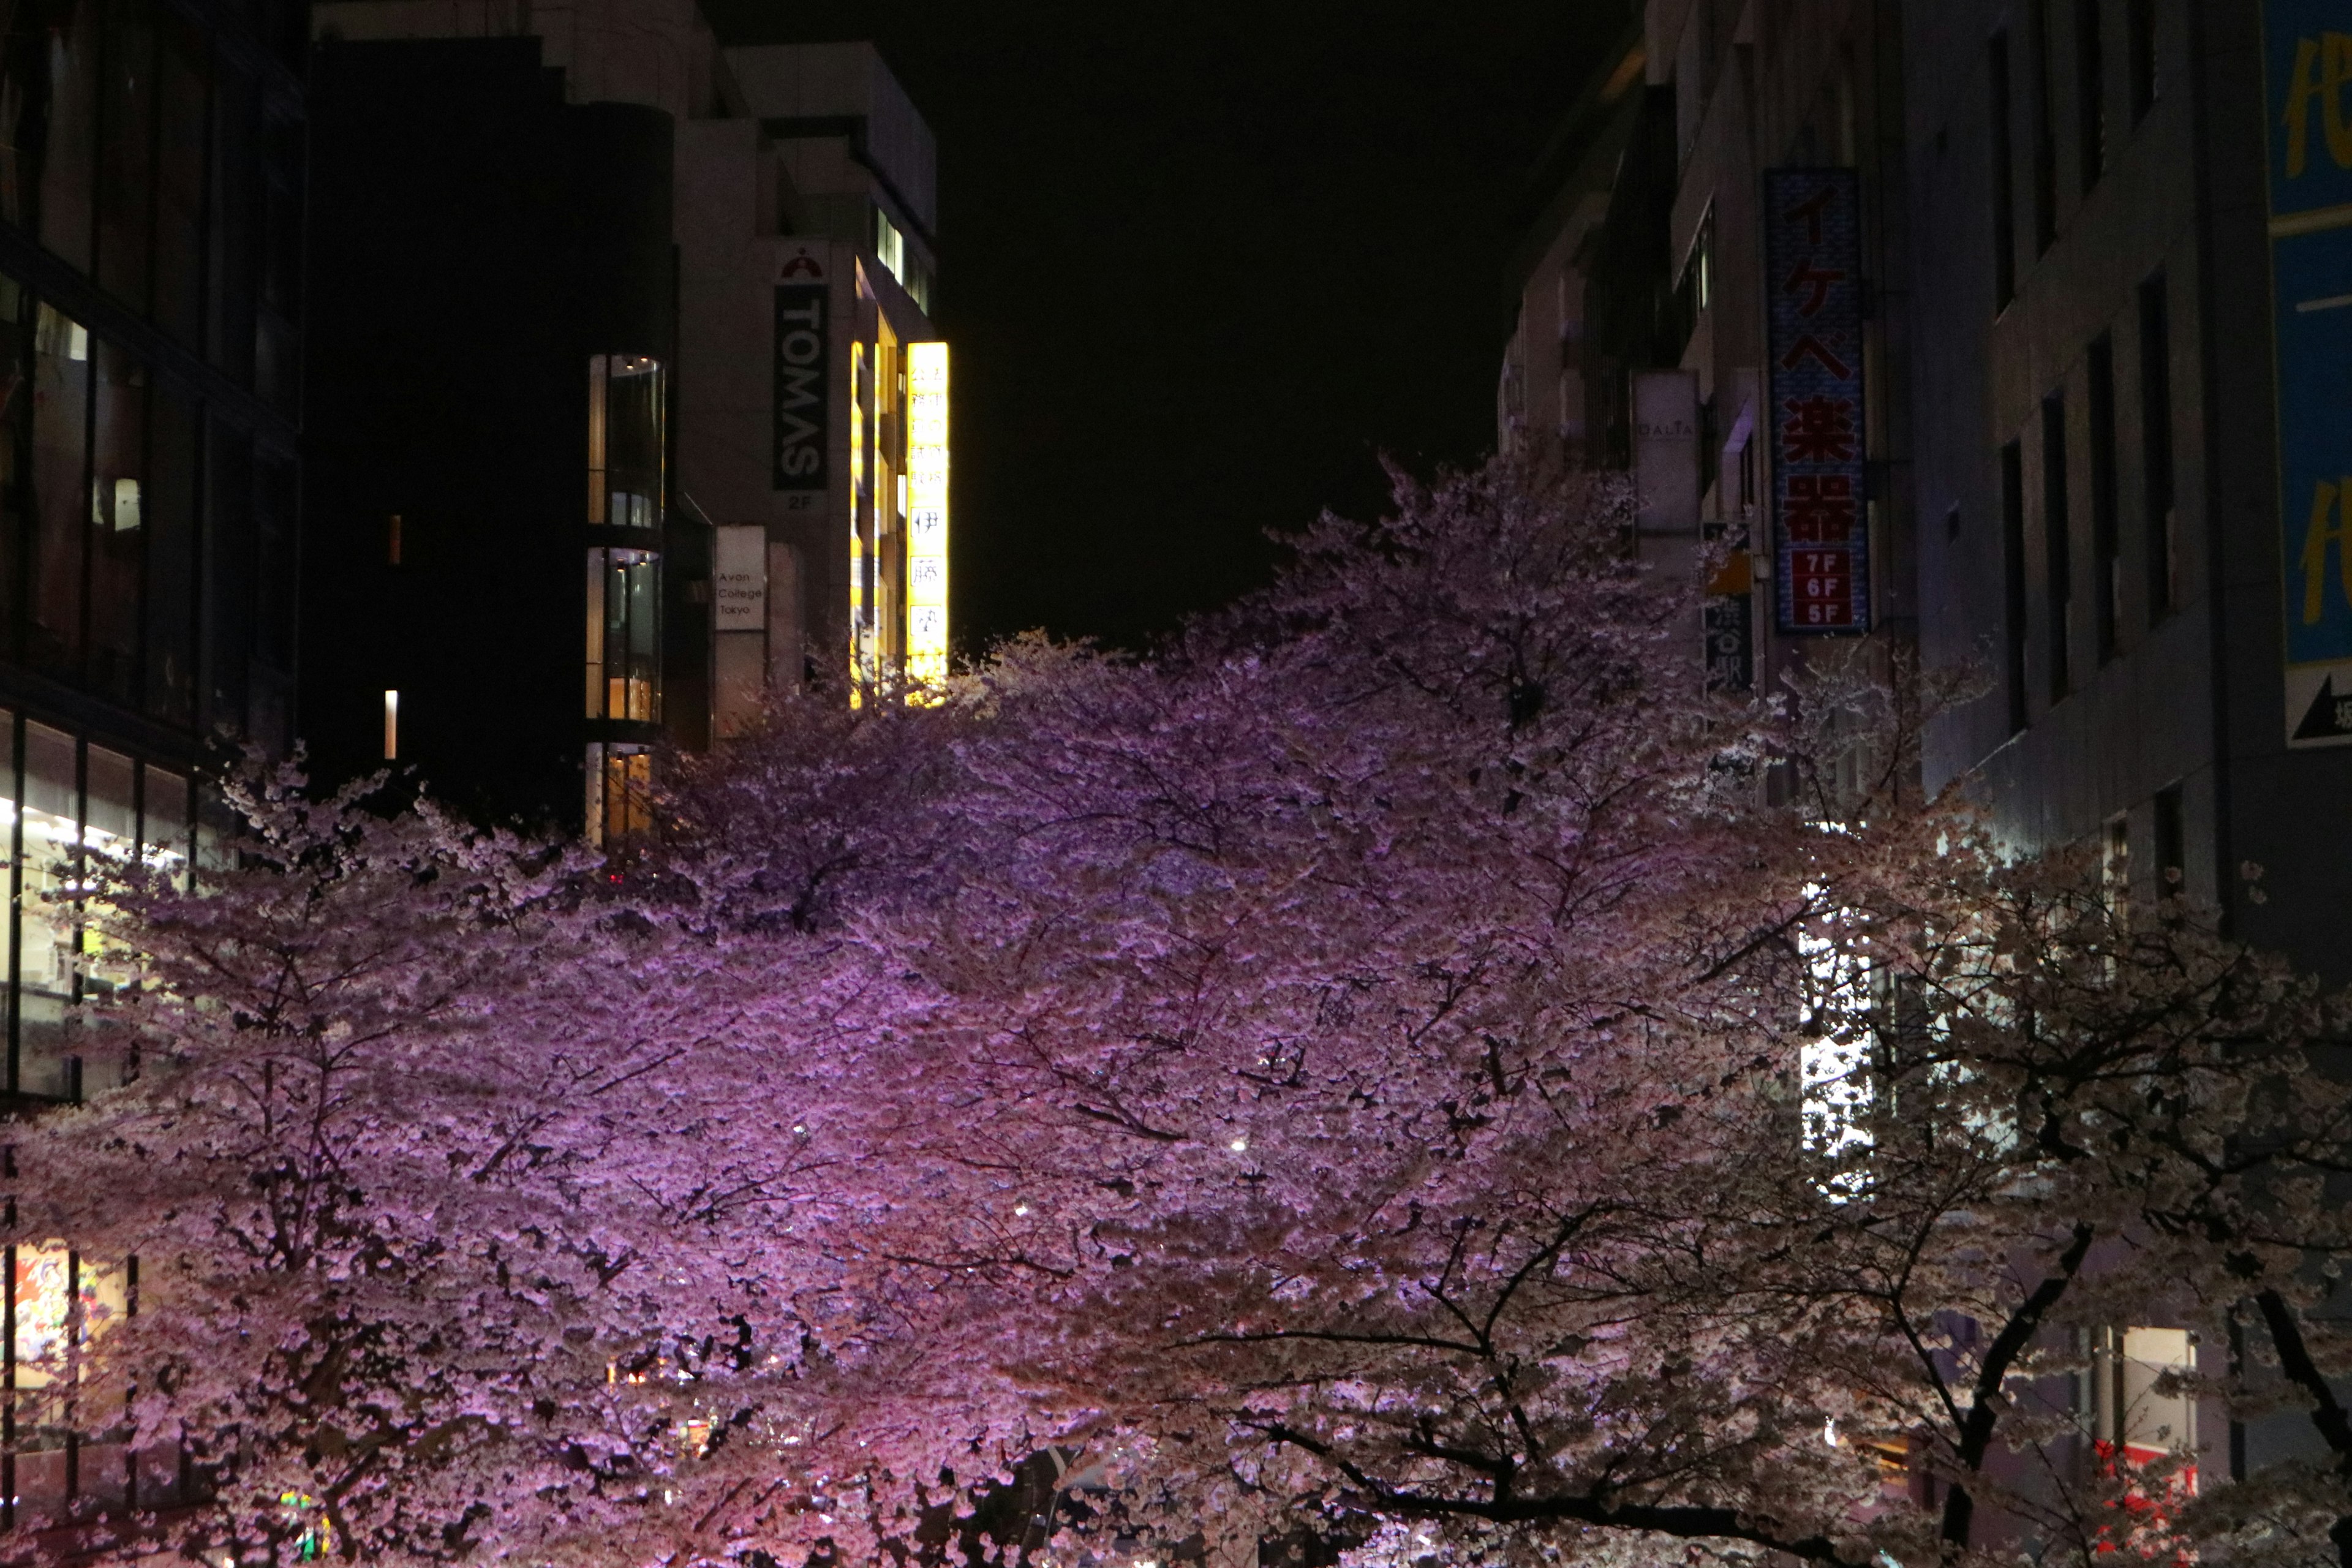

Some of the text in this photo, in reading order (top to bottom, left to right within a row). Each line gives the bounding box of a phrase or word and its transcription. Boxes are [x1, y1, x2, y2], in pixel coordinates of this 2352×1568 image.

[1781, 183, 1856, 543] イケベ楽器
[782, 298, 821, 478] TOMAS
[788, 495, 812, 510] 2F
[1807, 554, 1837, 572] 7F
[718, 589, 762, 600] College
[1807, 578, 1838, 597] 6F
[720, 605, 750, 616] Tokyo
[1808, 604, 1839, 622] 5F
[1714, 600, 1742, 690] 渋谷駅
